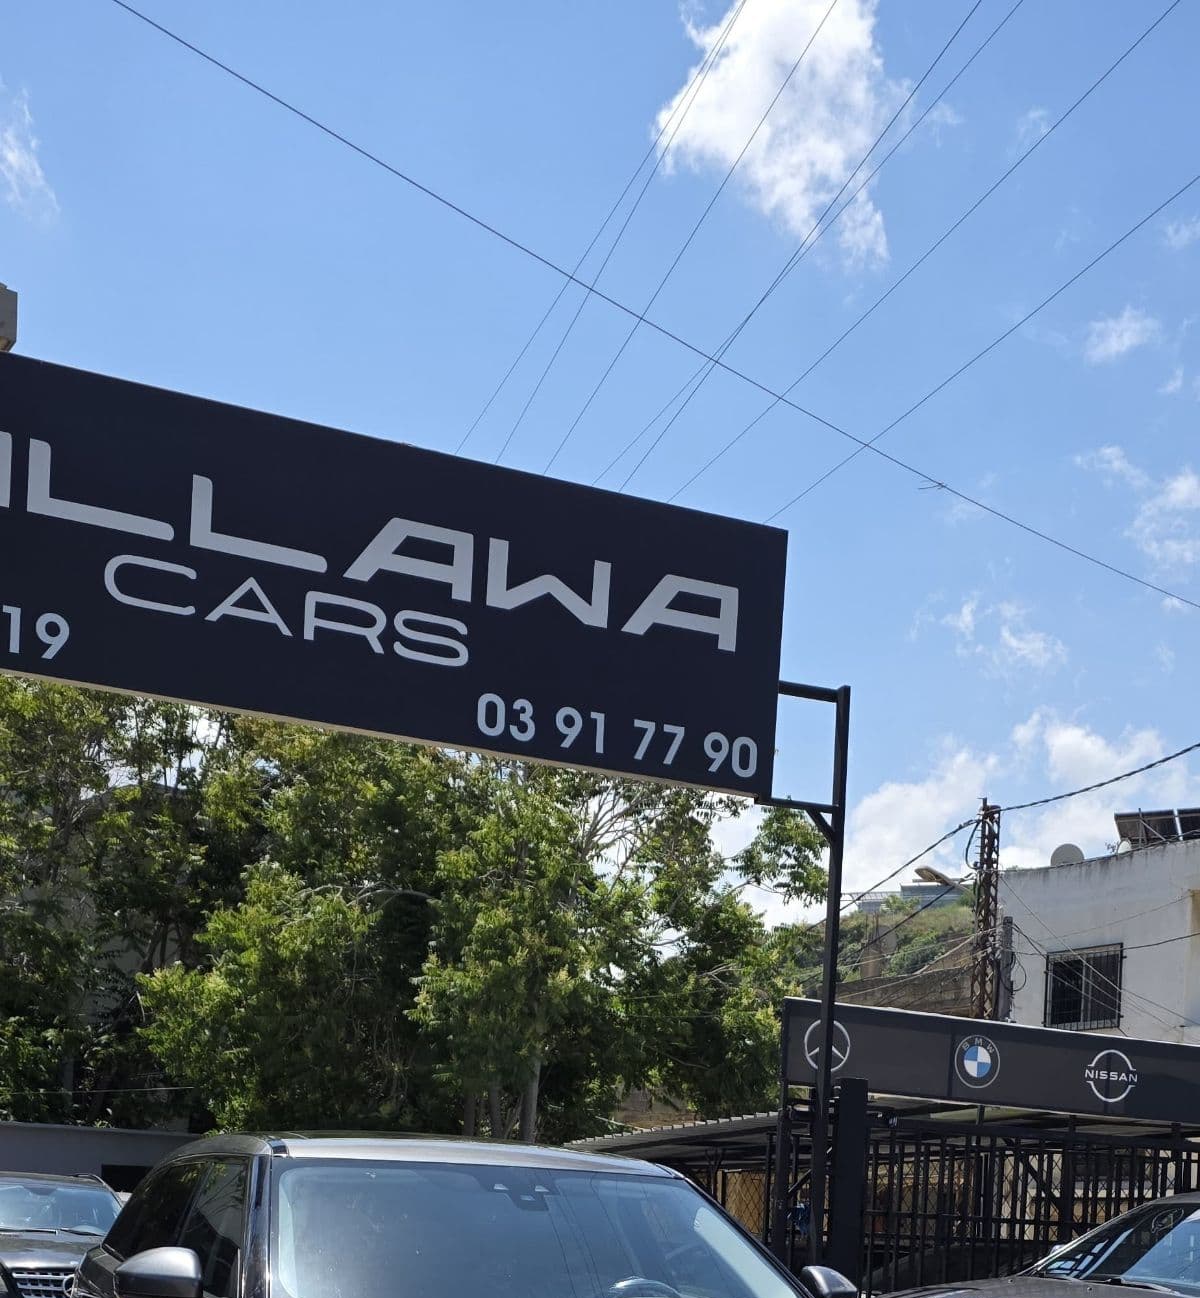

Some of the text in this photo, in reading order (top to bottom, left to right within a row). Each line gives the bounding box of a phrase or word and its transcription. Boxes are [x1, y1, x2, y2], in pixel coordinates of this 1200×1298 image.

[2, 604, 70, 660] 19
[103, 554, 469, 667] CARS
[477, 692, 758, 778] 03 91 77 90
[961, 1037, 995, 1053] BMW
[1084, 1068, 1138, 1083] NISSAN
